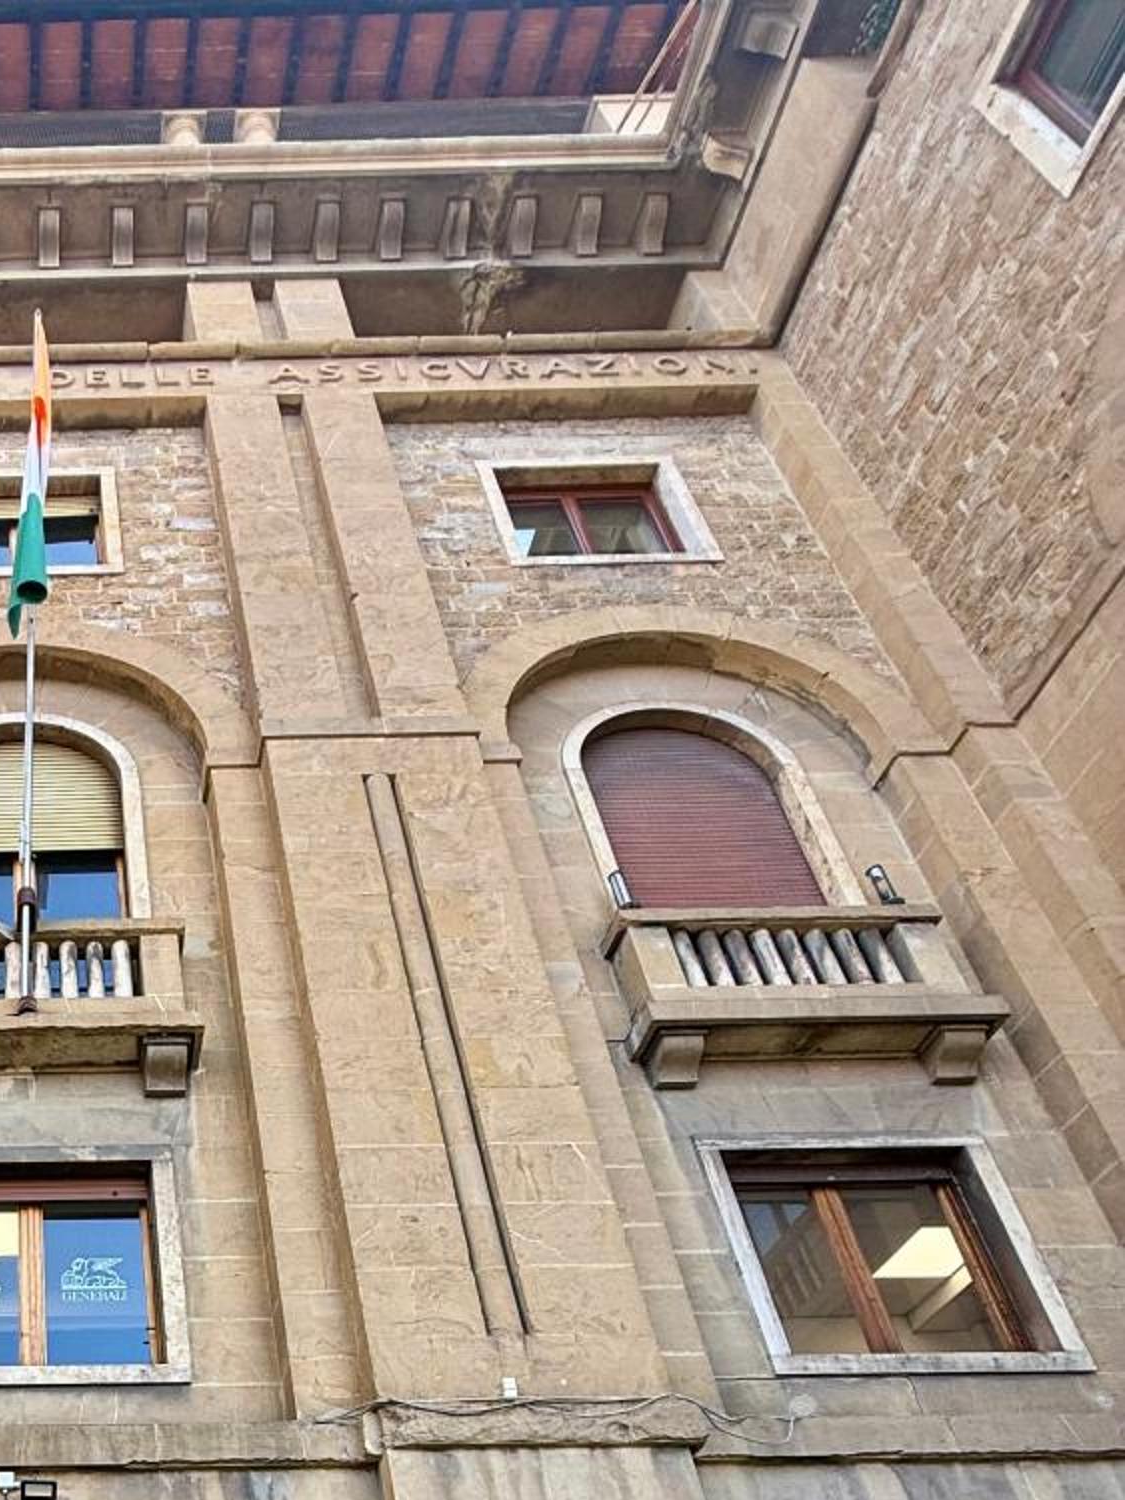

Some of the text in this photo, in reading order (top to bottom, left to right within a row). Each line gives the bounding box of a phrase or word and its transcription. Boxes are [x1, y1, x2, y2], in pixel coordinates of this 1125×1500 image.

[48, 367, 215, 389] DELLE
[268, 354, 759, 385] ASSICVRAZIONI
[62, 1290, 127, 1301] GENERALI
